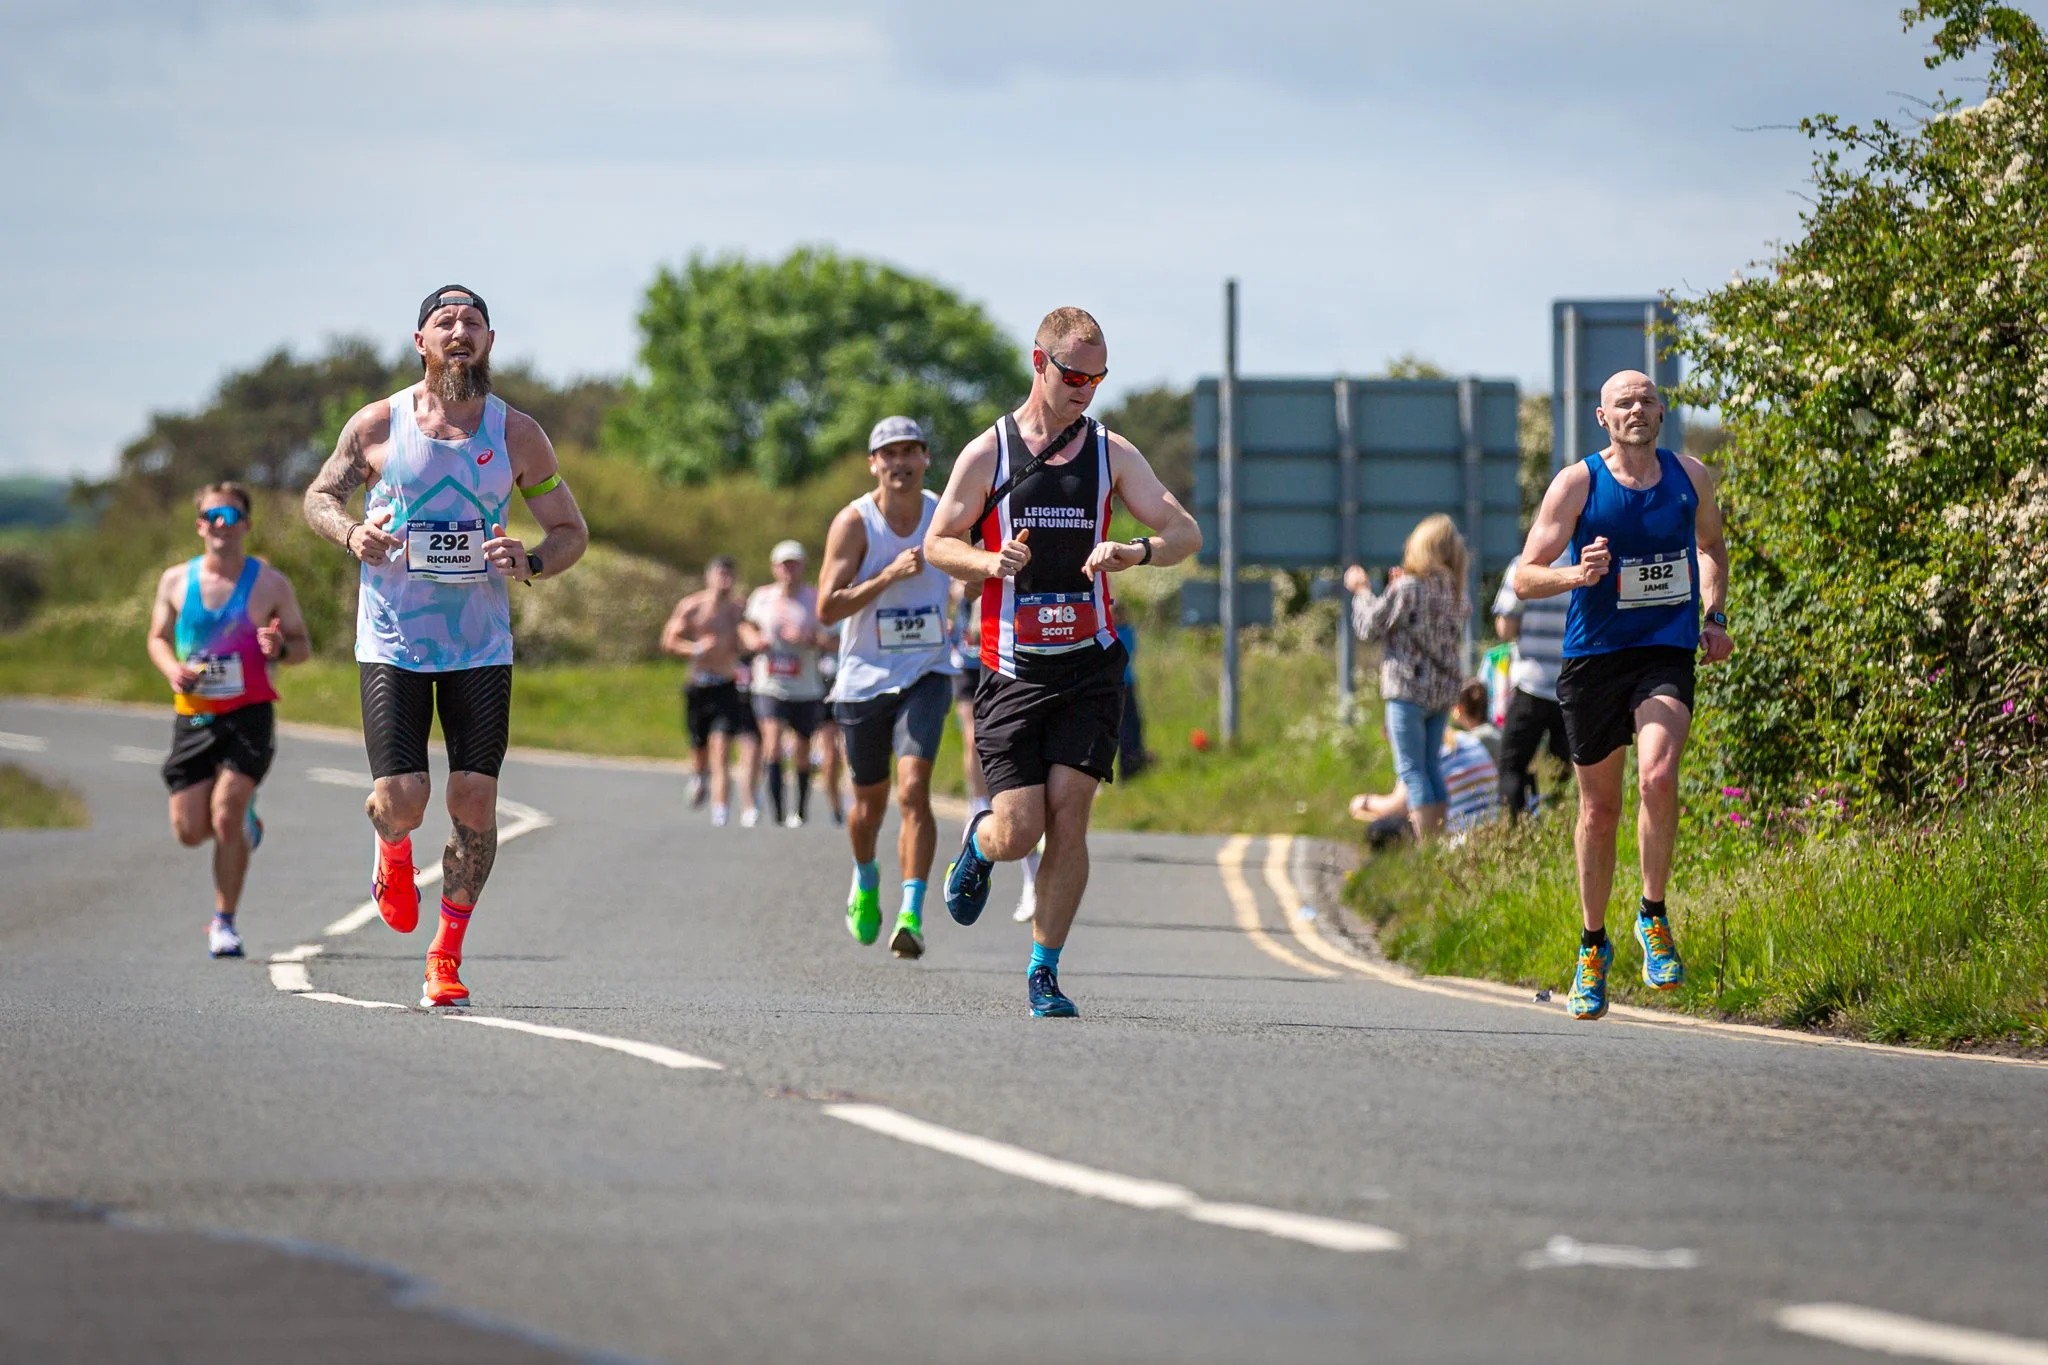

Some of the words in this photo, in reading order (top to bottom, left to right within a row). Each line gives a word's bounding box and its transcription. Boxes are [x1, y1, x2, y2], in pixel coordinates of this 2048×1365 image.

[1024, 507, 1085, 518] LEIGHTON
[1013, 518, 1036, 528] FUN
[1039, 519, 1095, 529] RUNNERS
[429, 534, 469, 551] 292
[427, 555, 471, 564] RICHARD
[1639, 564, 1673, 581] 382
[1644, 583, 1669, 592] JAMIE
[1038, 605, 1077, 624] 818
[894, 617, 926, 632] 399
[1041, 627, 1075, 636] SCOTT
